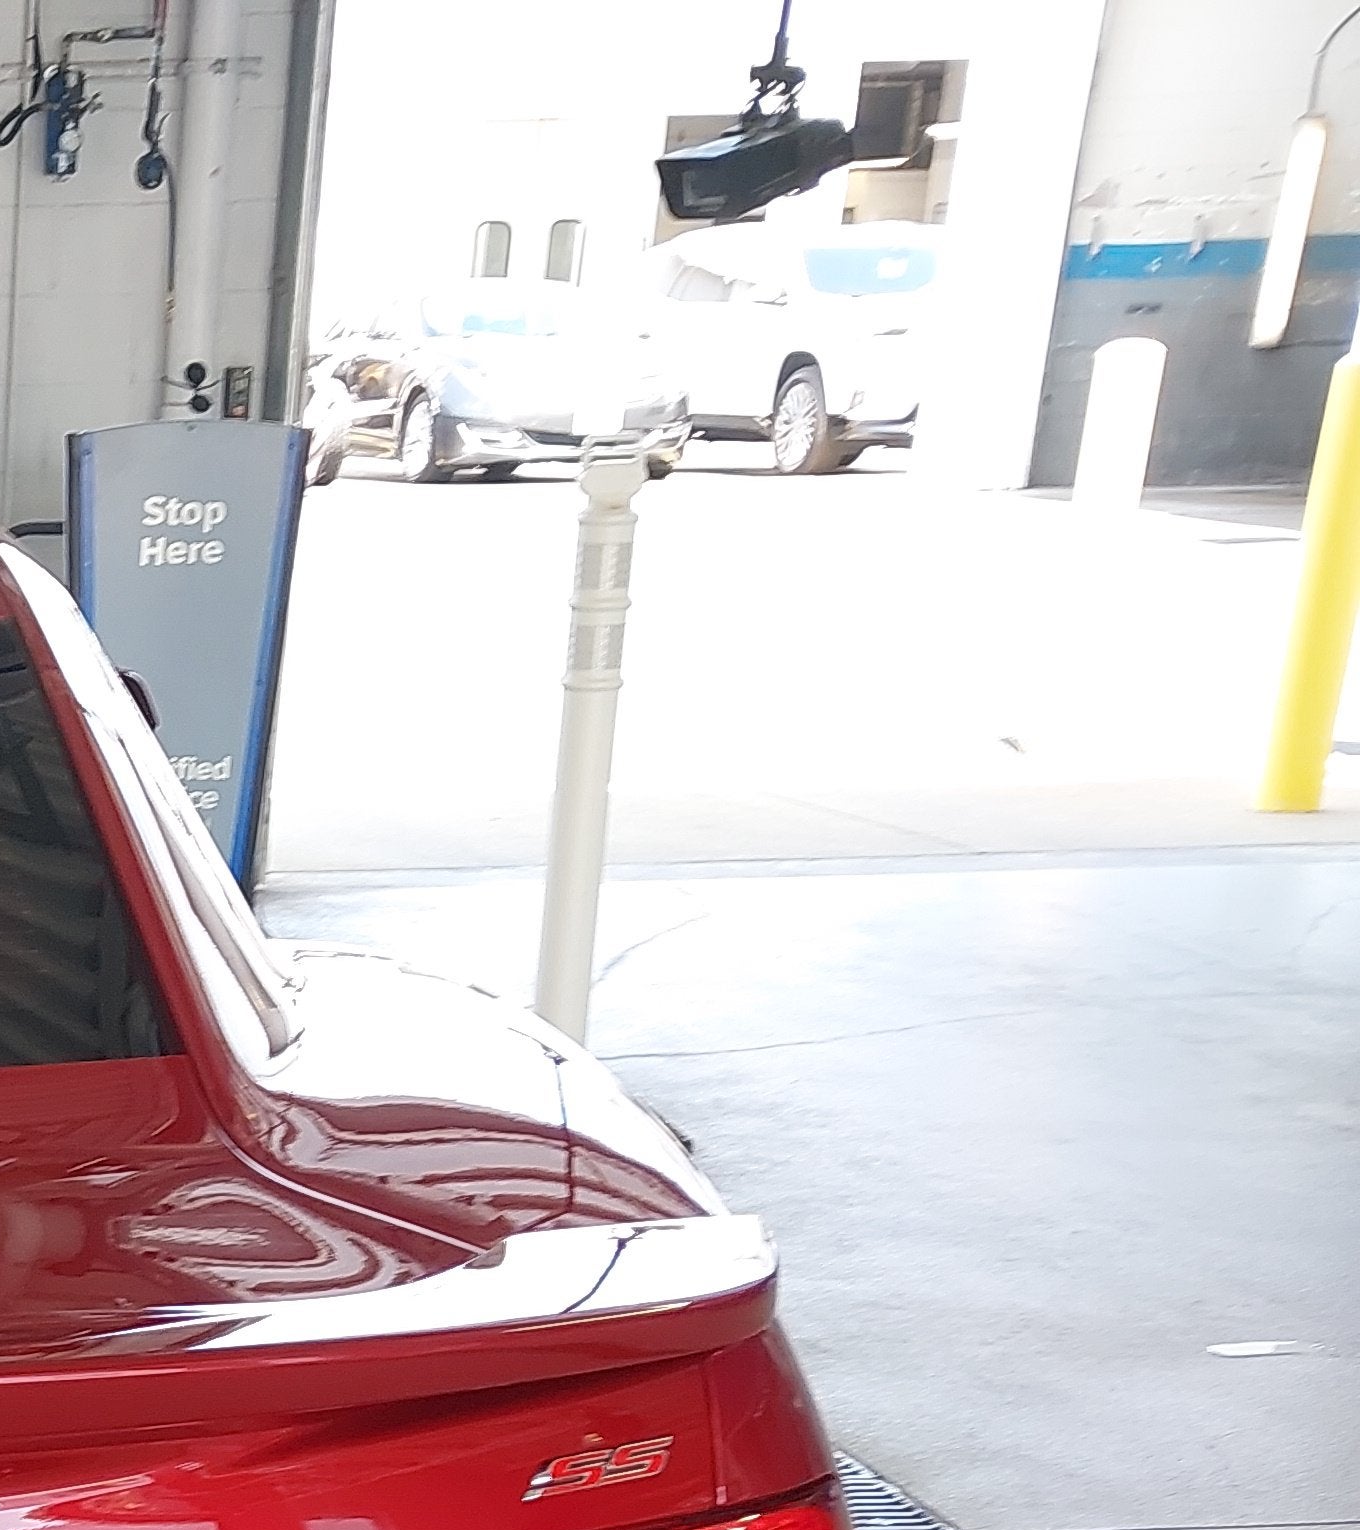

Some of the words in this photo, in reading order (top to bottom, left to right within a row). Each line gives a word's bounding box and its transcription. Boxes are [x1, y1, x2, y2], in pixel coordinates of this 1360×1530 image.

[141, 496, 228, 533] Stop
[139, 537, 225, 566] Here
[521, 1435, 674, 1502] SS
